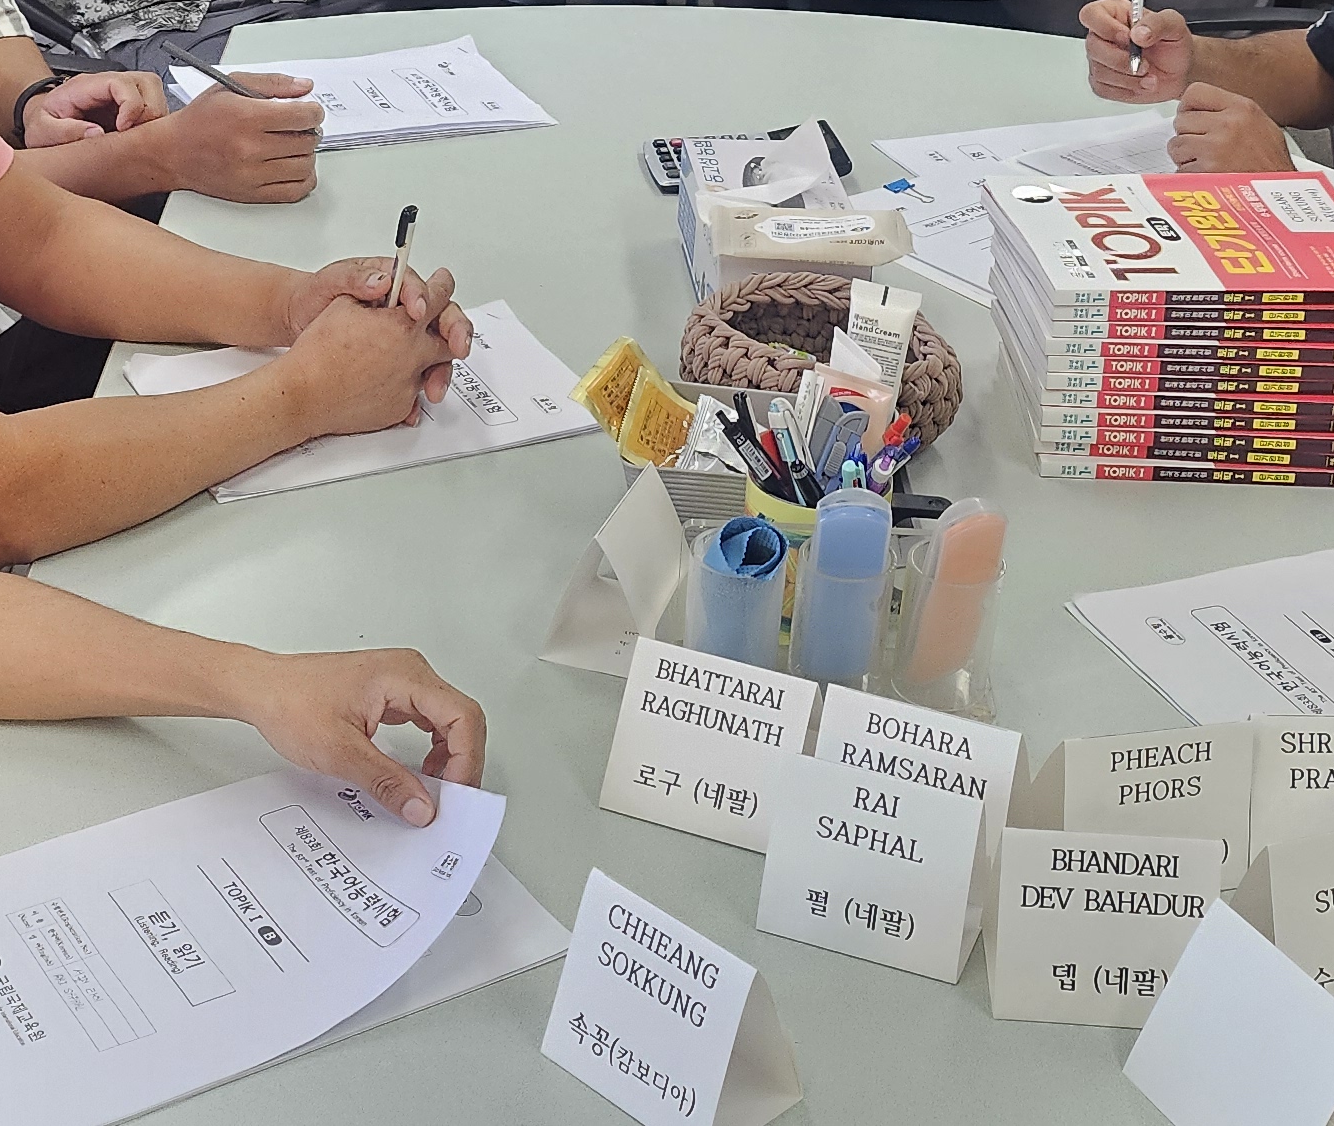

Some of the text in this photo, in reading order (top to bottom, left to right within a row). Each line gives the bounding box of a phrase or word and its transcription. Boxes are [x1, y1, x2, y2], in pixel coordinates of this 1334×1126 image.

[1051, 182, 1180, 282] TOPIK
[1164, 191, 1276, 275] 단기완성
[1116, 309, 1147, 318] TOPIK
[1117, 293, 1149, 302] TOPIK
[852, 322, 901, 339] Hand Cream
[1117, 326, 1147, 335] TOPIK
[1108, 345, 1140, 354] TOPIK
[1111, 362, 1143, 371] TOPIK
[1109, 378, 1141, 388] TOPIK
[1105, 396, 1136, 405] TOPIK
[1104, 432, 1136, 441] TOPIK
[1105, 416, 1137, 425] TOPIK
[1098, 445, 1130, 454] TOPIK
[1104, 467, 1135, 477] TOPIK
[1210, 622, 1300, 692] 한국어능력시험
[655, 657, 785, 711] BHATTARAI
[640, 690, 784, 748] RAGHUNATH
[866, 712, 973, 761] BOHARA
[840, 742, 987, 801] RAMSARAN
[1110, 740, 1213, 772] PHEACH
[633, 763, 759, 820] 로구 (네팔)
[852, 786, 901, 819] RAI
[1118, 776, 1203, 806] PHORS
[350, 799, 375, 821] TOPIK
[816, 816, 924, 864] SAPHAL
[295, 825, 403, 928] 제83회 한국어능력시험
[1050, 848, 1180, 879] BHANDARI
[223, 880, 257, 915] TOPIK
[805, 887, 916, 940] 펄 (네팔)
[1020, 885, 1205, 919] DEV BAHADUR
[148, 911, 206, 970] 듣기, 읽기
[608, 902, 720, 990] CHHEANG
[597, 941, 707, 1028] SOKKUNG
[1051, 963, 1169, 998] 뎁 (네팔)
[568, 1010, 698, 1118] 속꽁(캄보디아)
